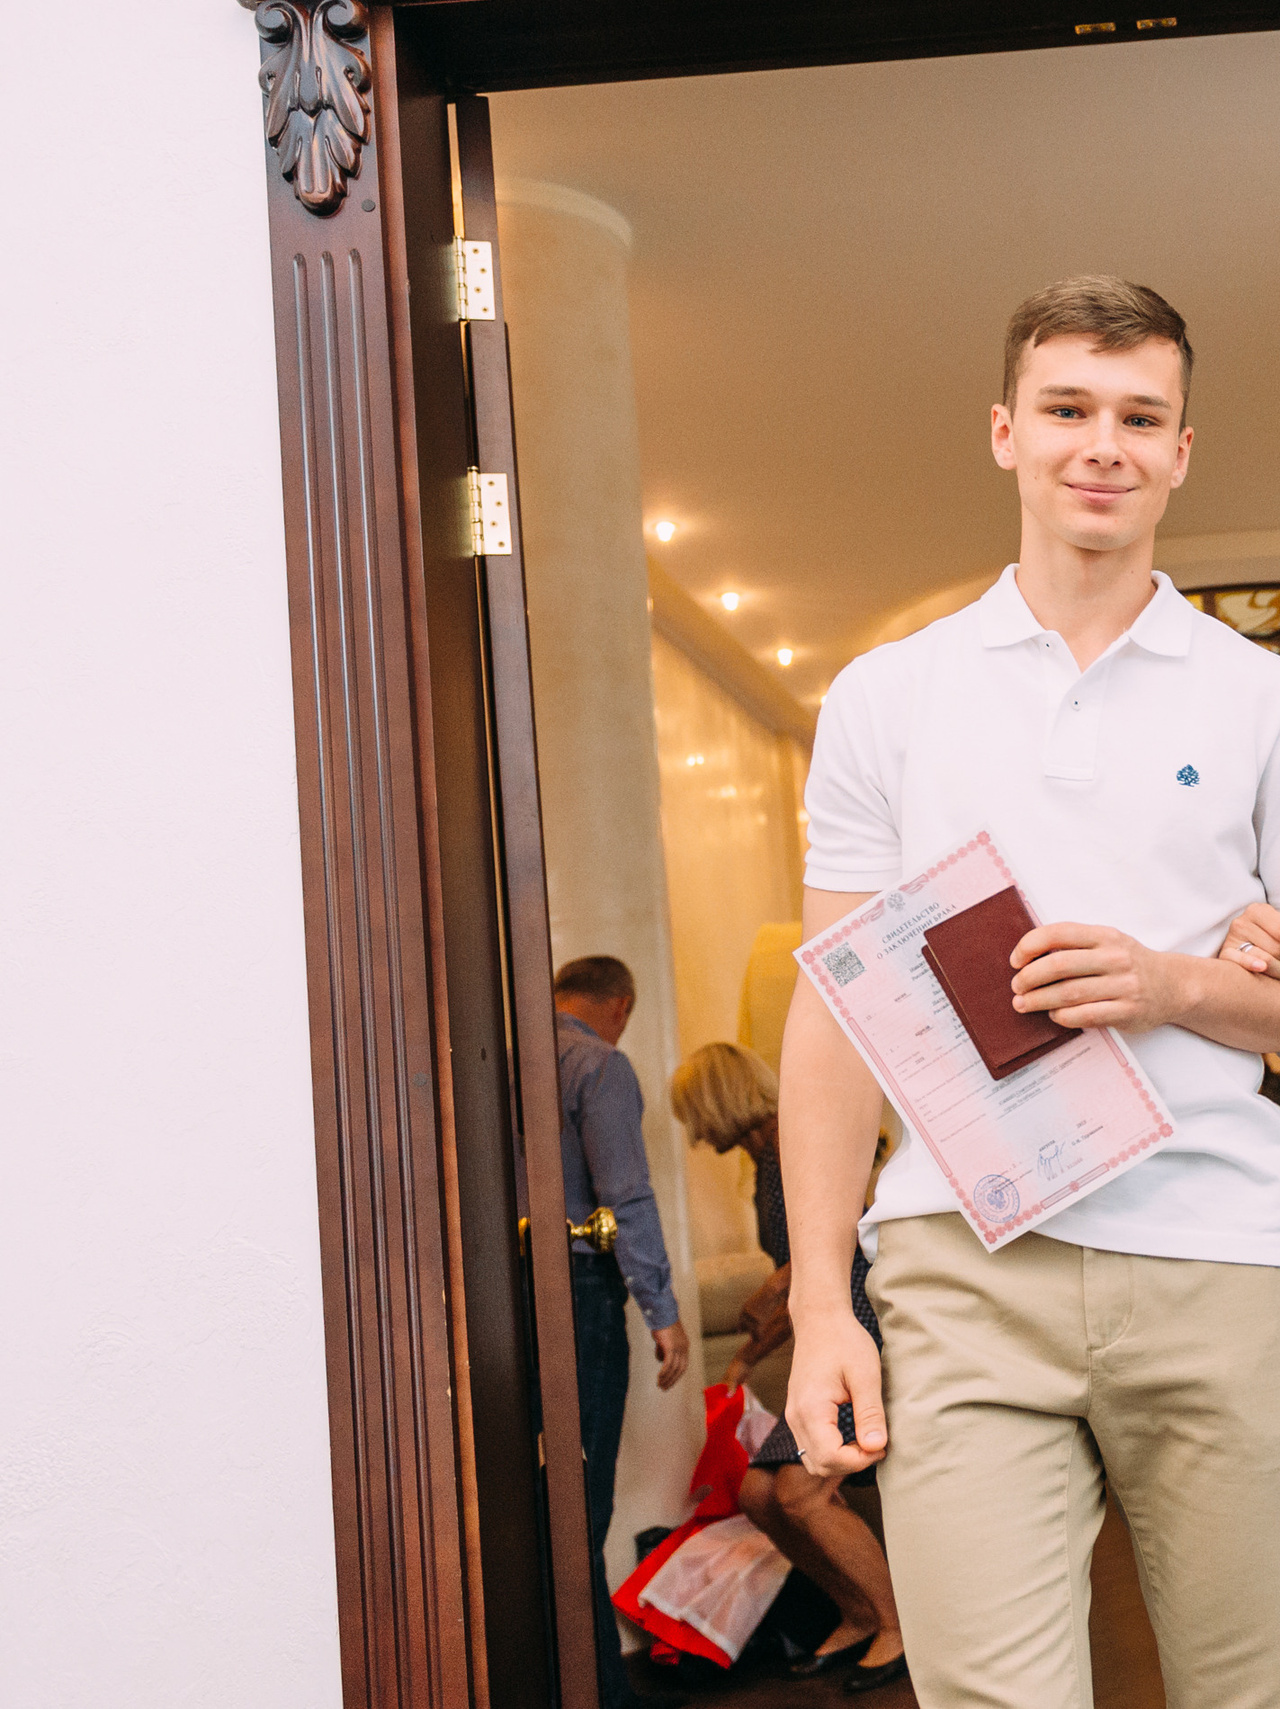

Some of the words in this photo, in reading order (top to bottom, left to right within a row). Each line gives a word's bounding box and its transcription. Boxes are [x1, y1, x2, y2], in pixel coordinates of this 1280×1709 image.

[883, 902, 940, 944] СВИДЕТЕЛЬСТВО
[884, 918, 932, 954] ЗАКЛЮЧЕНИИ
[934, 903, 956, 922] БРАКА
